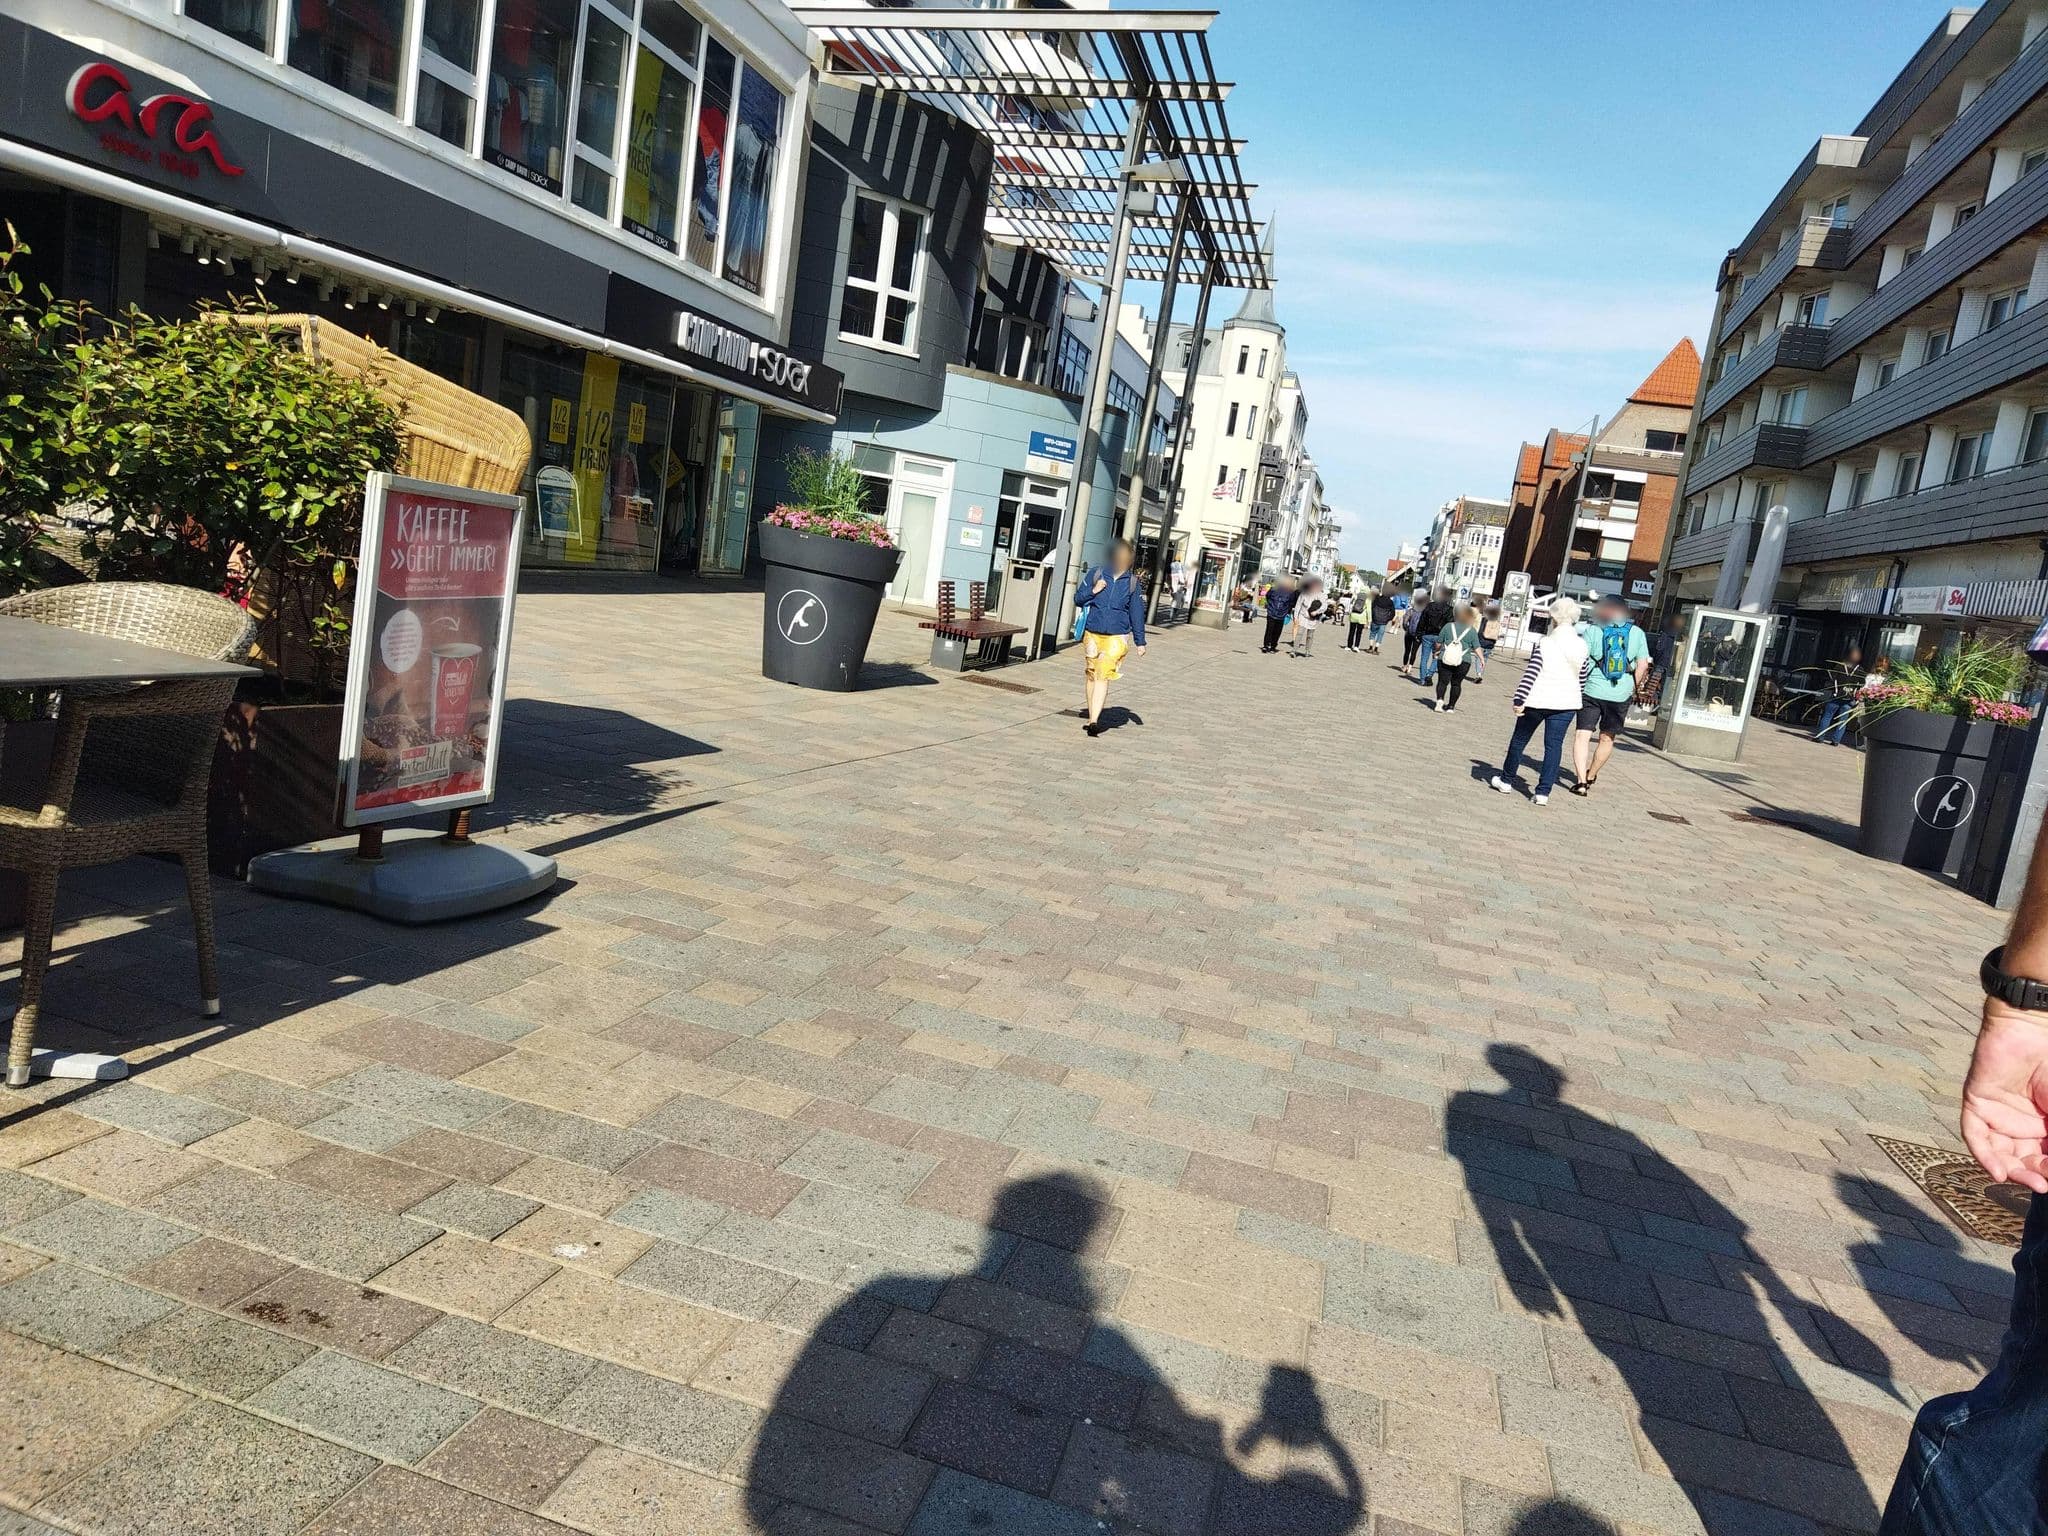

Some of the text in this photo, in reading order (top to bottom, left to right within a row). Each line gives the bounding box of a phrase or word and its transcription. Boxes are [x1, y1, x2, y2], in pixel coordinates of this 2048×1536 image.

[66, 62, 246, 176] ara
[677, 312, 718, 359] CAMP
[716, 326, 751, 372] DAVID
[555, 405, 568, 423] 1/2
[632, 407, 643, 425] 1/2
[553, 422, 566, 434] PREIS
[584, 408, 611, 448] 1/2
[579, 447, 608, 472] PREIS
[397, 503, 470, 544] KAFFEE
[450, 544, 496, 572] IMMER!
[1634, 581, 1648, 590] VIA
